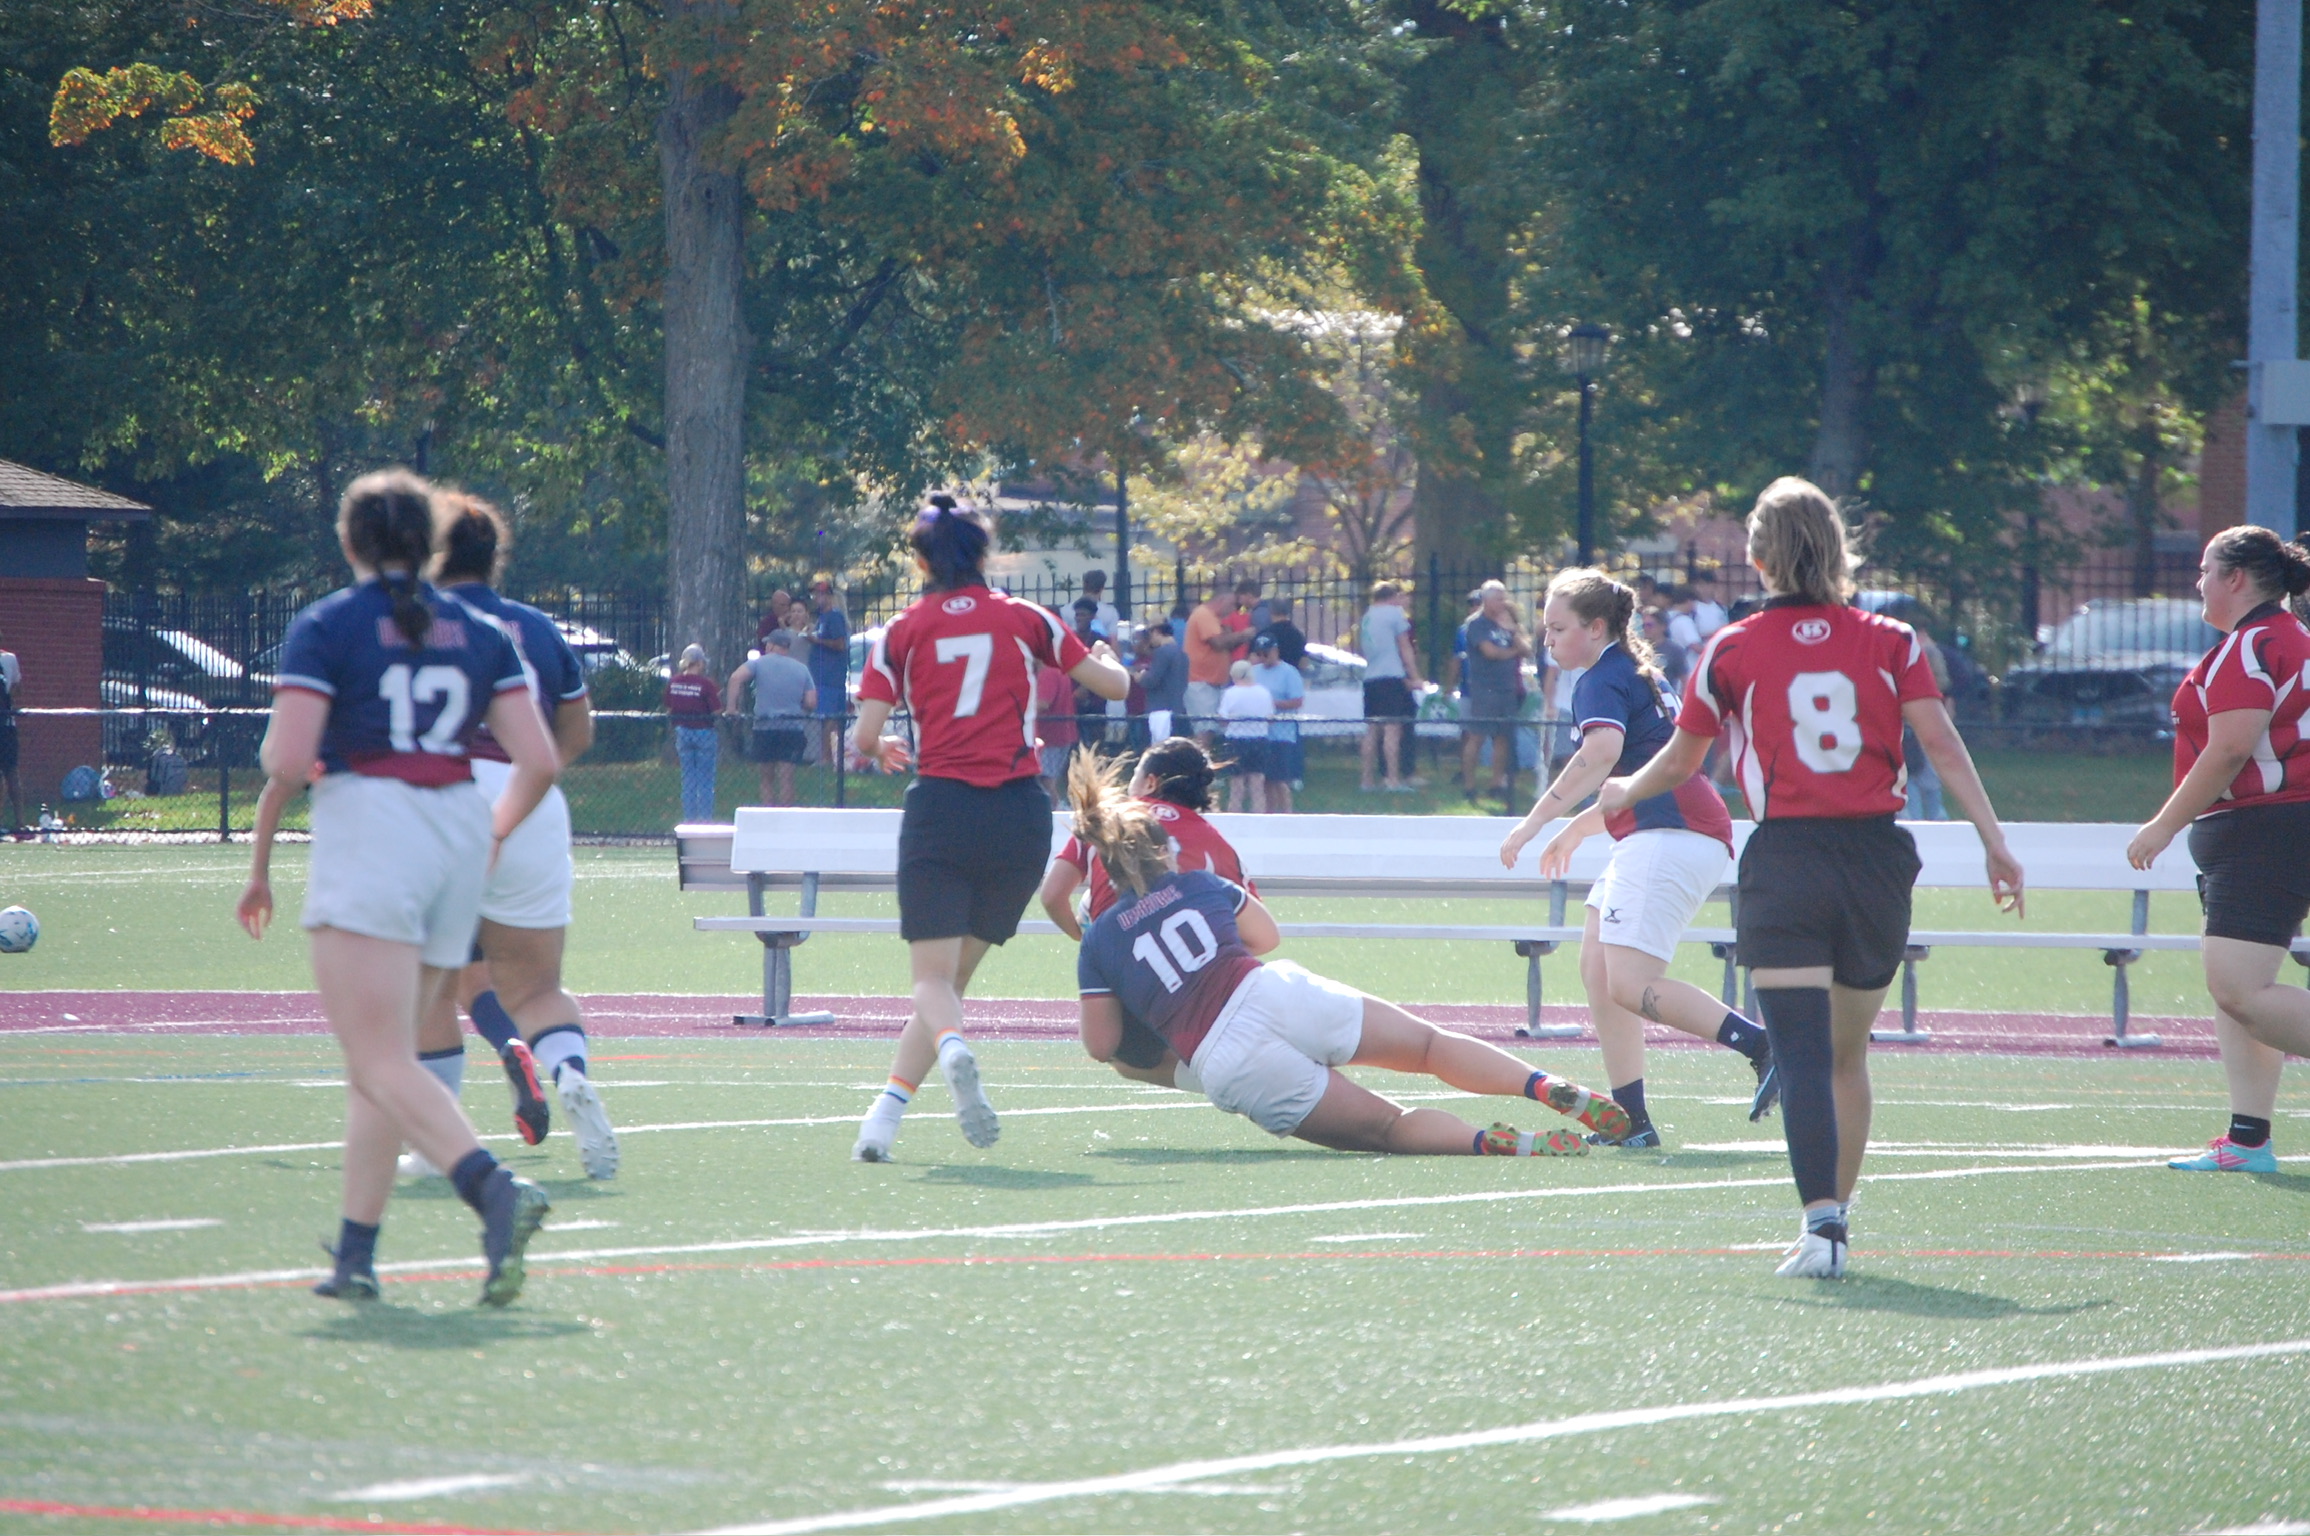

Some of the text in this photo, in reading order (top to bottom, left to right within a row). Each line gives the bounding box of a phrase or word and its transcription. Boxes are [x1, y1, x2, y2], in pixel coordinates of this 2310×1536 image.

[378, 663, 471, 756] 12
[935, 633, 993, 719] 7
[1787, 670, 1863, 774] 8
[1131, 908, 1219, 994] 10
